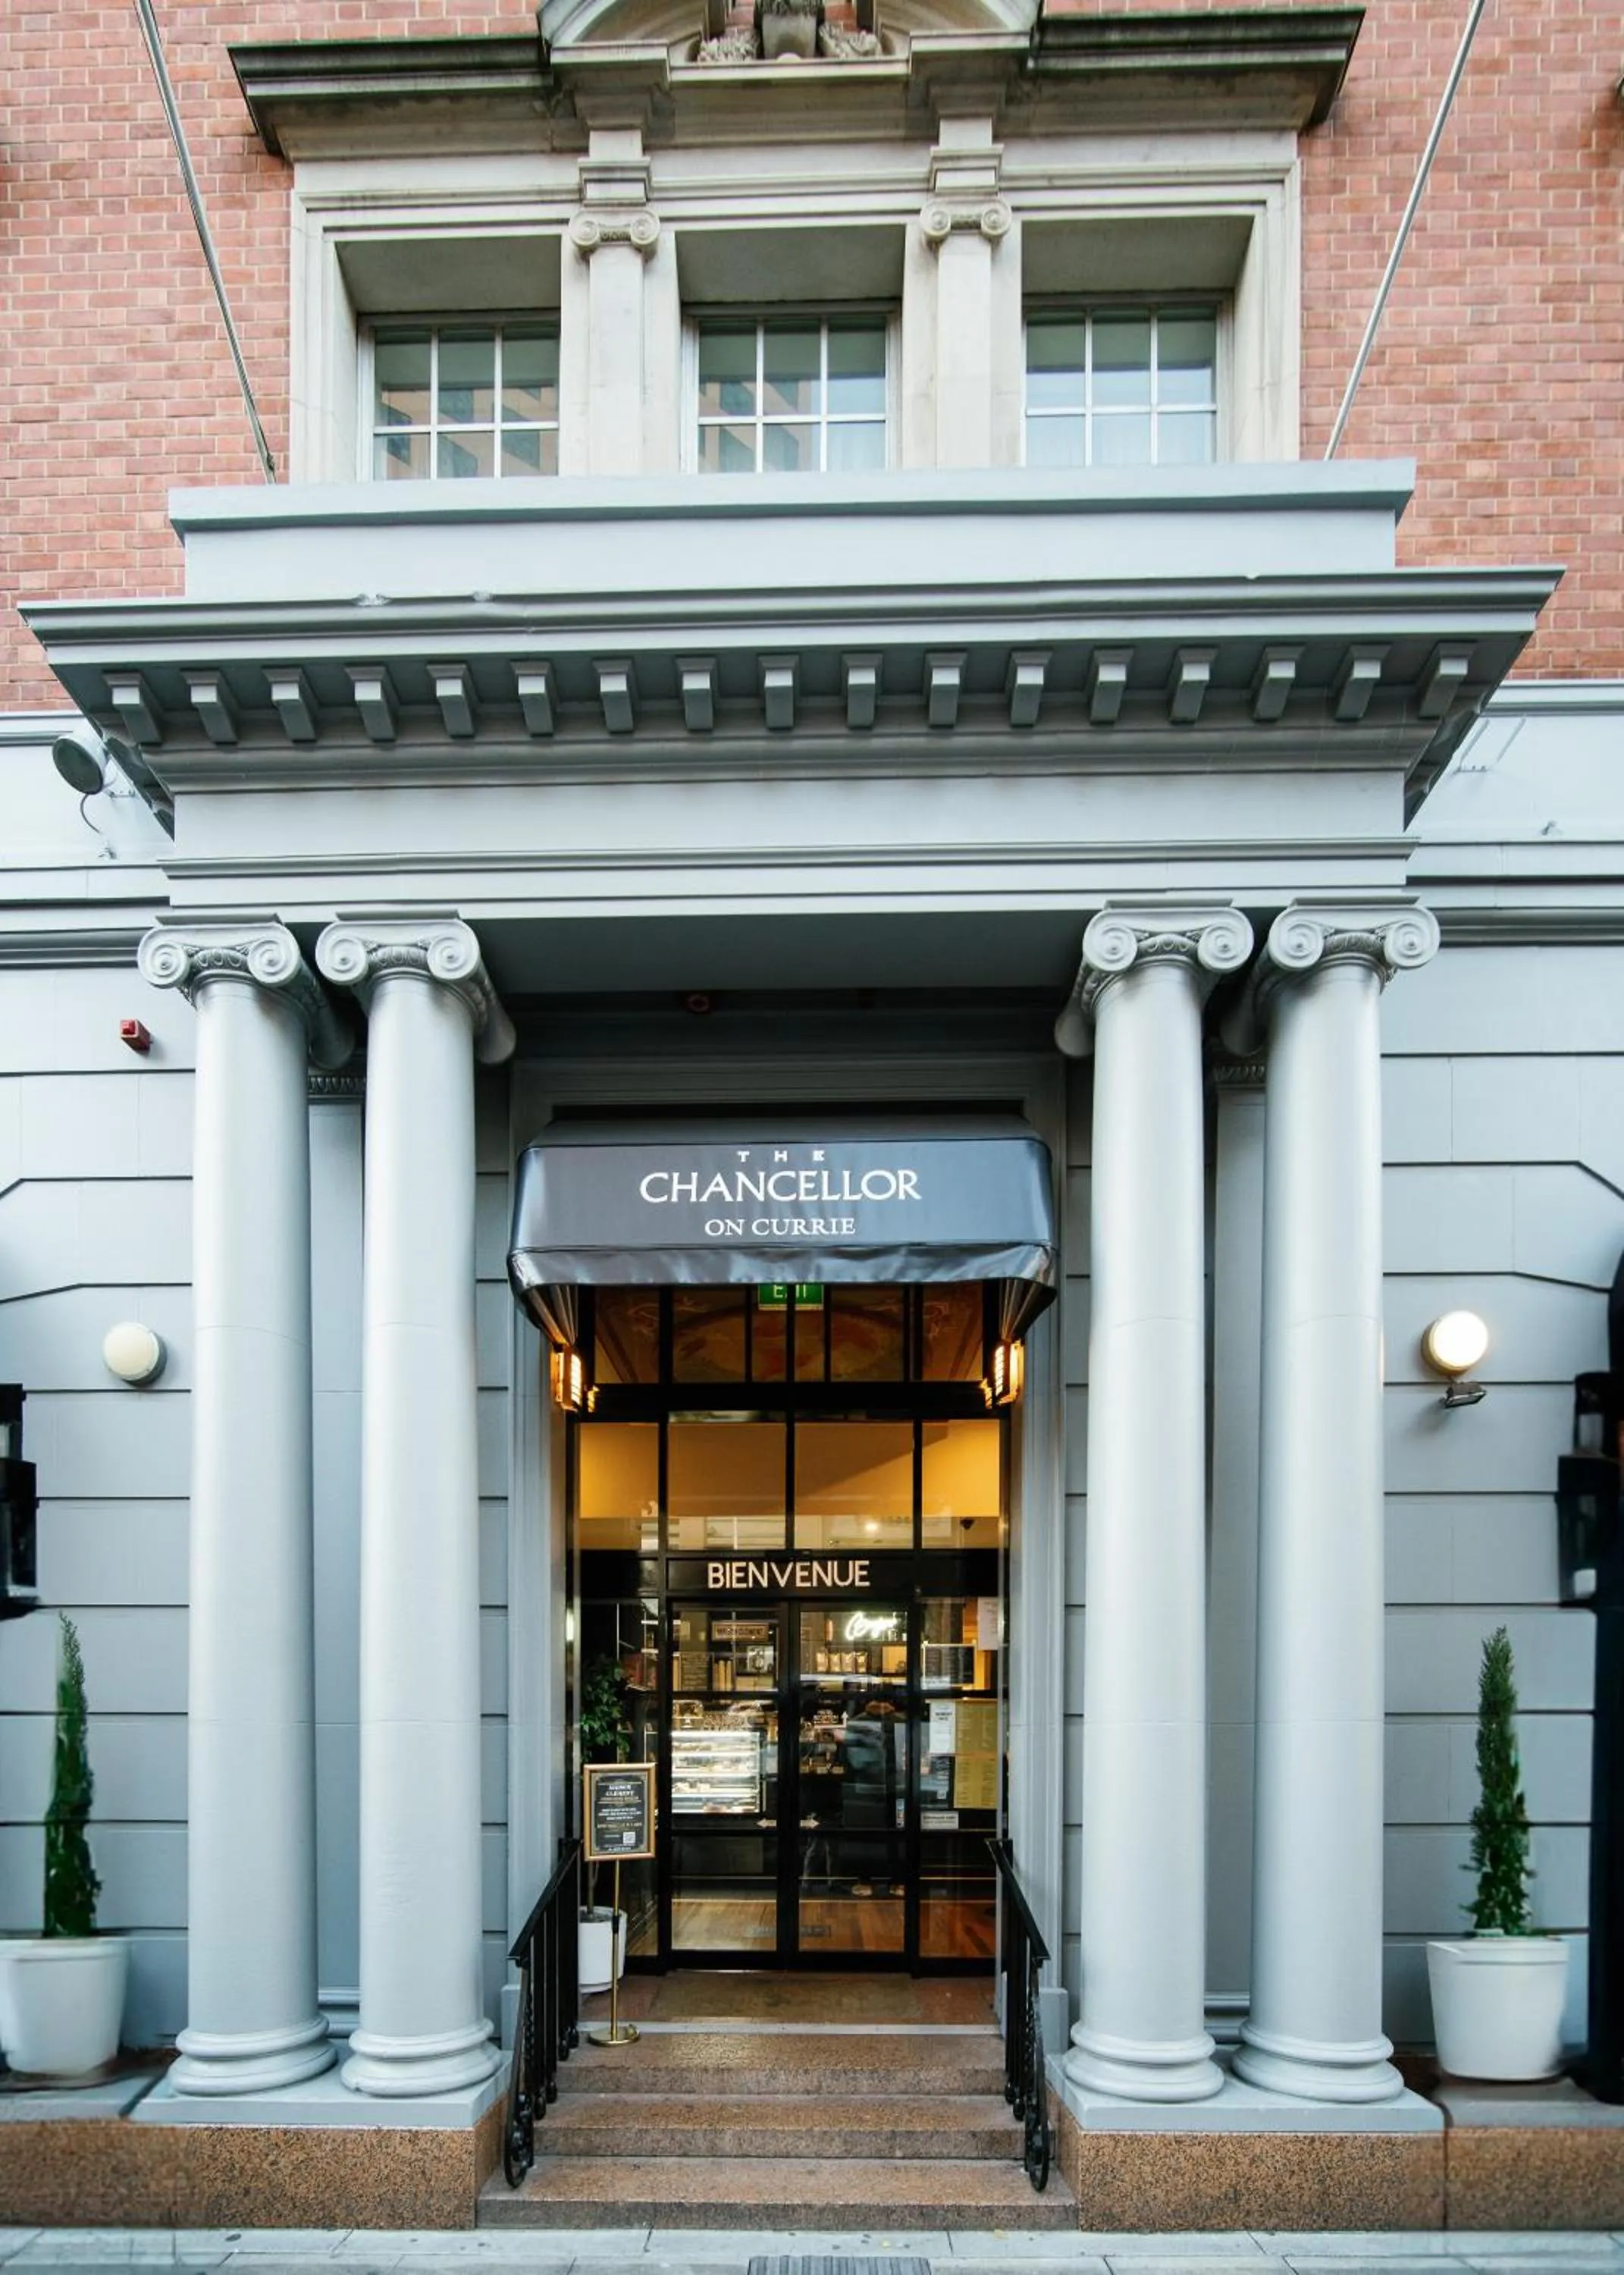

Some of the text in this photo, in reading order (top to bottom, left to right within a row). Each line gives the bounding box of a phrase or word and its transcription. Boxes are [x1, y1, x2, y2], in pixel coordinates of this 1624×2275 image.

[737, 1150, 825, 1163] THE
[639, 1169, 922, 1203] CHANCELLOR
[704, 1217, 856, 1236] ON CURRIE
[773, 1284, 807, 1299] EIT
[707, 1560, 870, 1588] BIENVENUE
